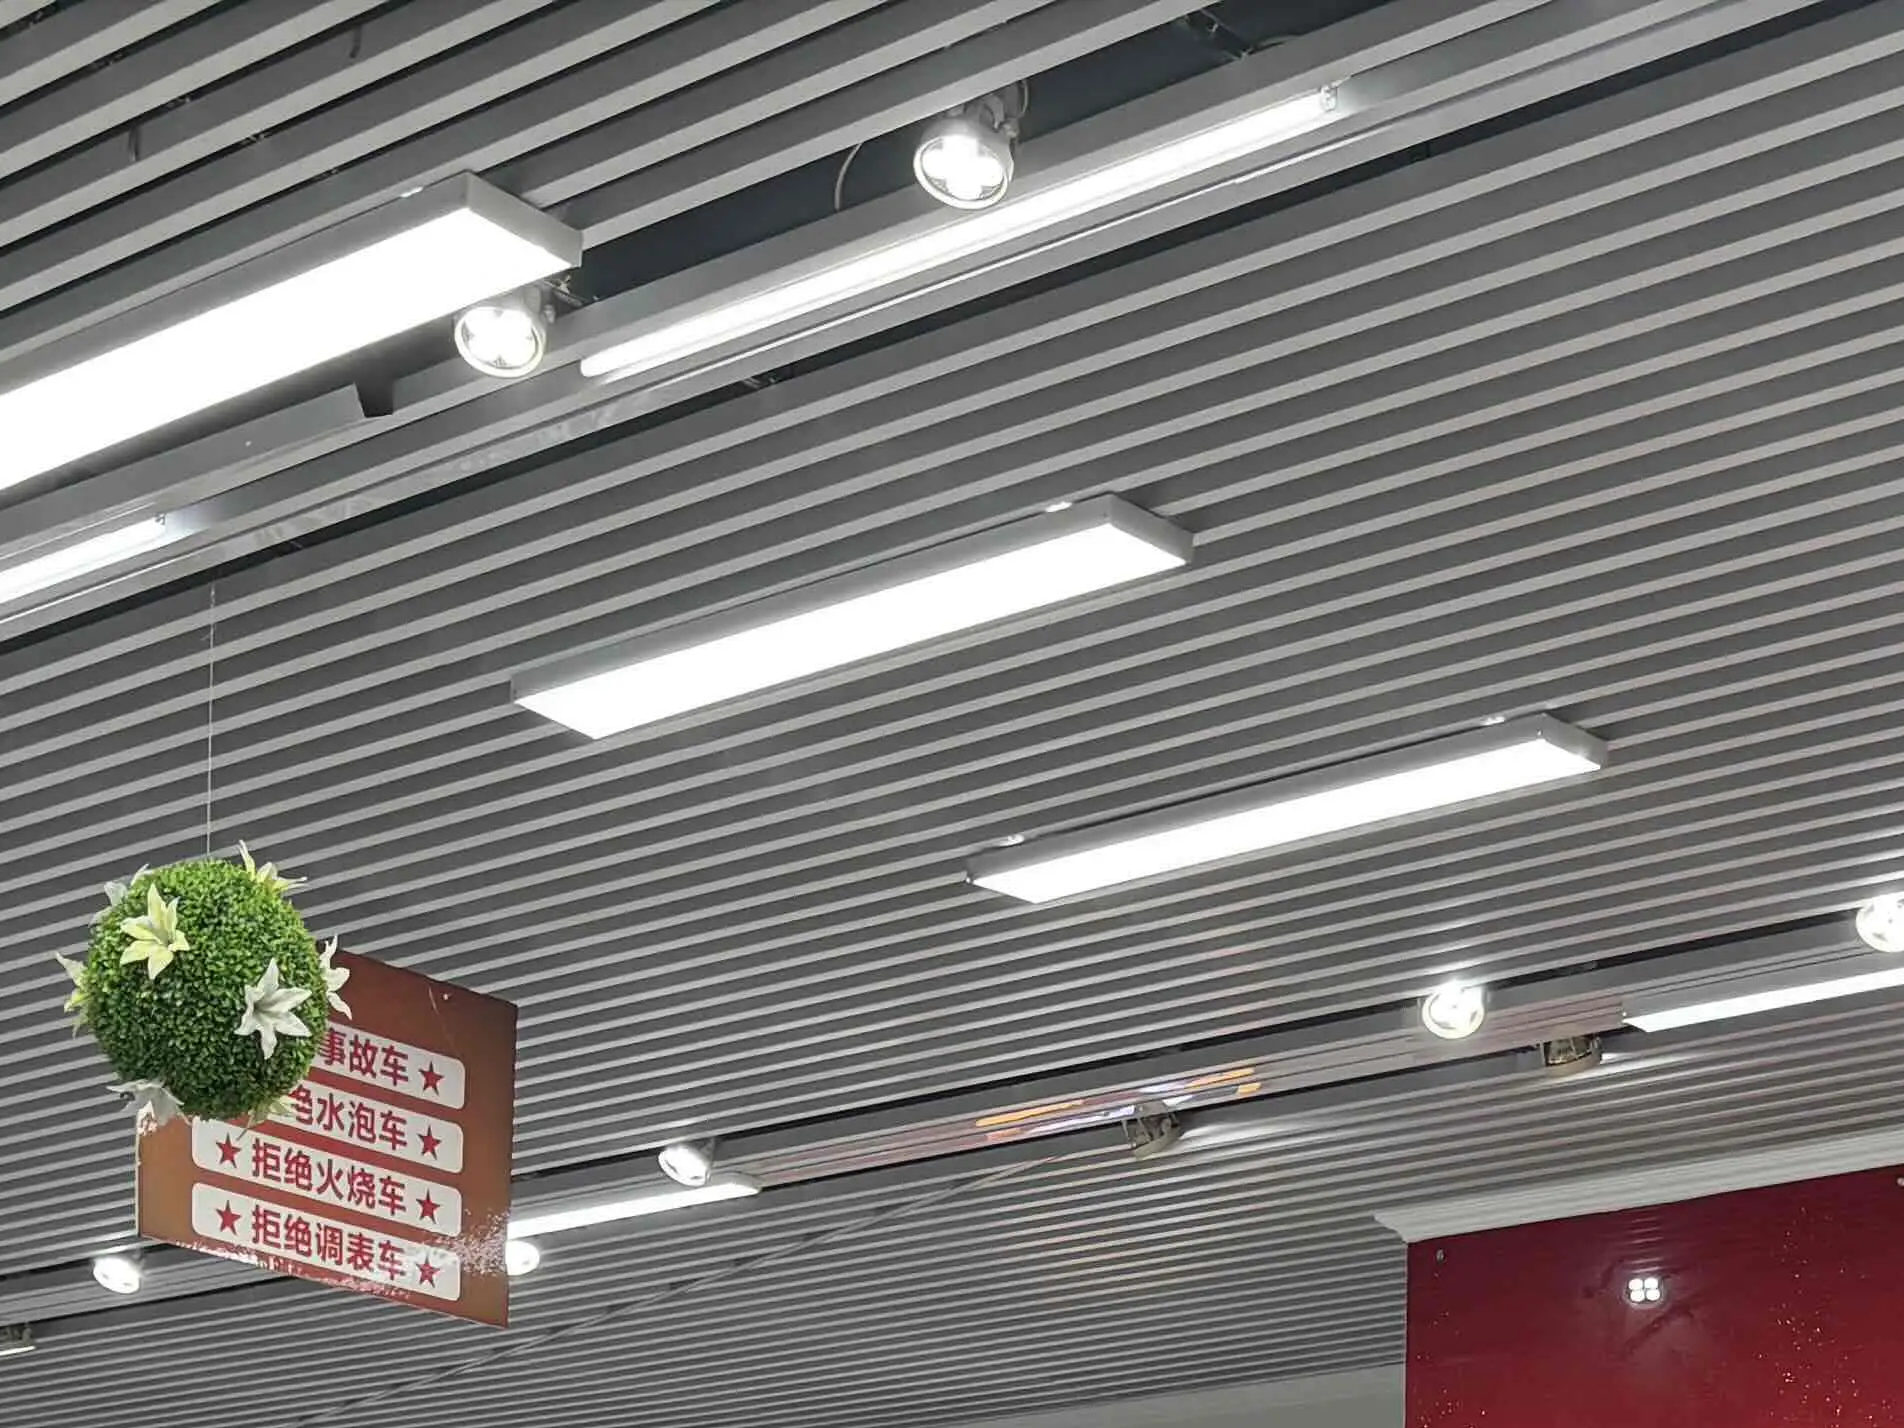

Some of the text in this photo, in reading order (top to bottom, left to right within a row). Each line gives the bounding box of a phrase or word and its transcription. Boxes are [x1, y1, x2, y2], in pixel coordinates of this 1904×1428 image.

[252, 1137, 407, 1216] 拒绝火烧车
[252, 1204, 406, 1281] 拒绝调表车
